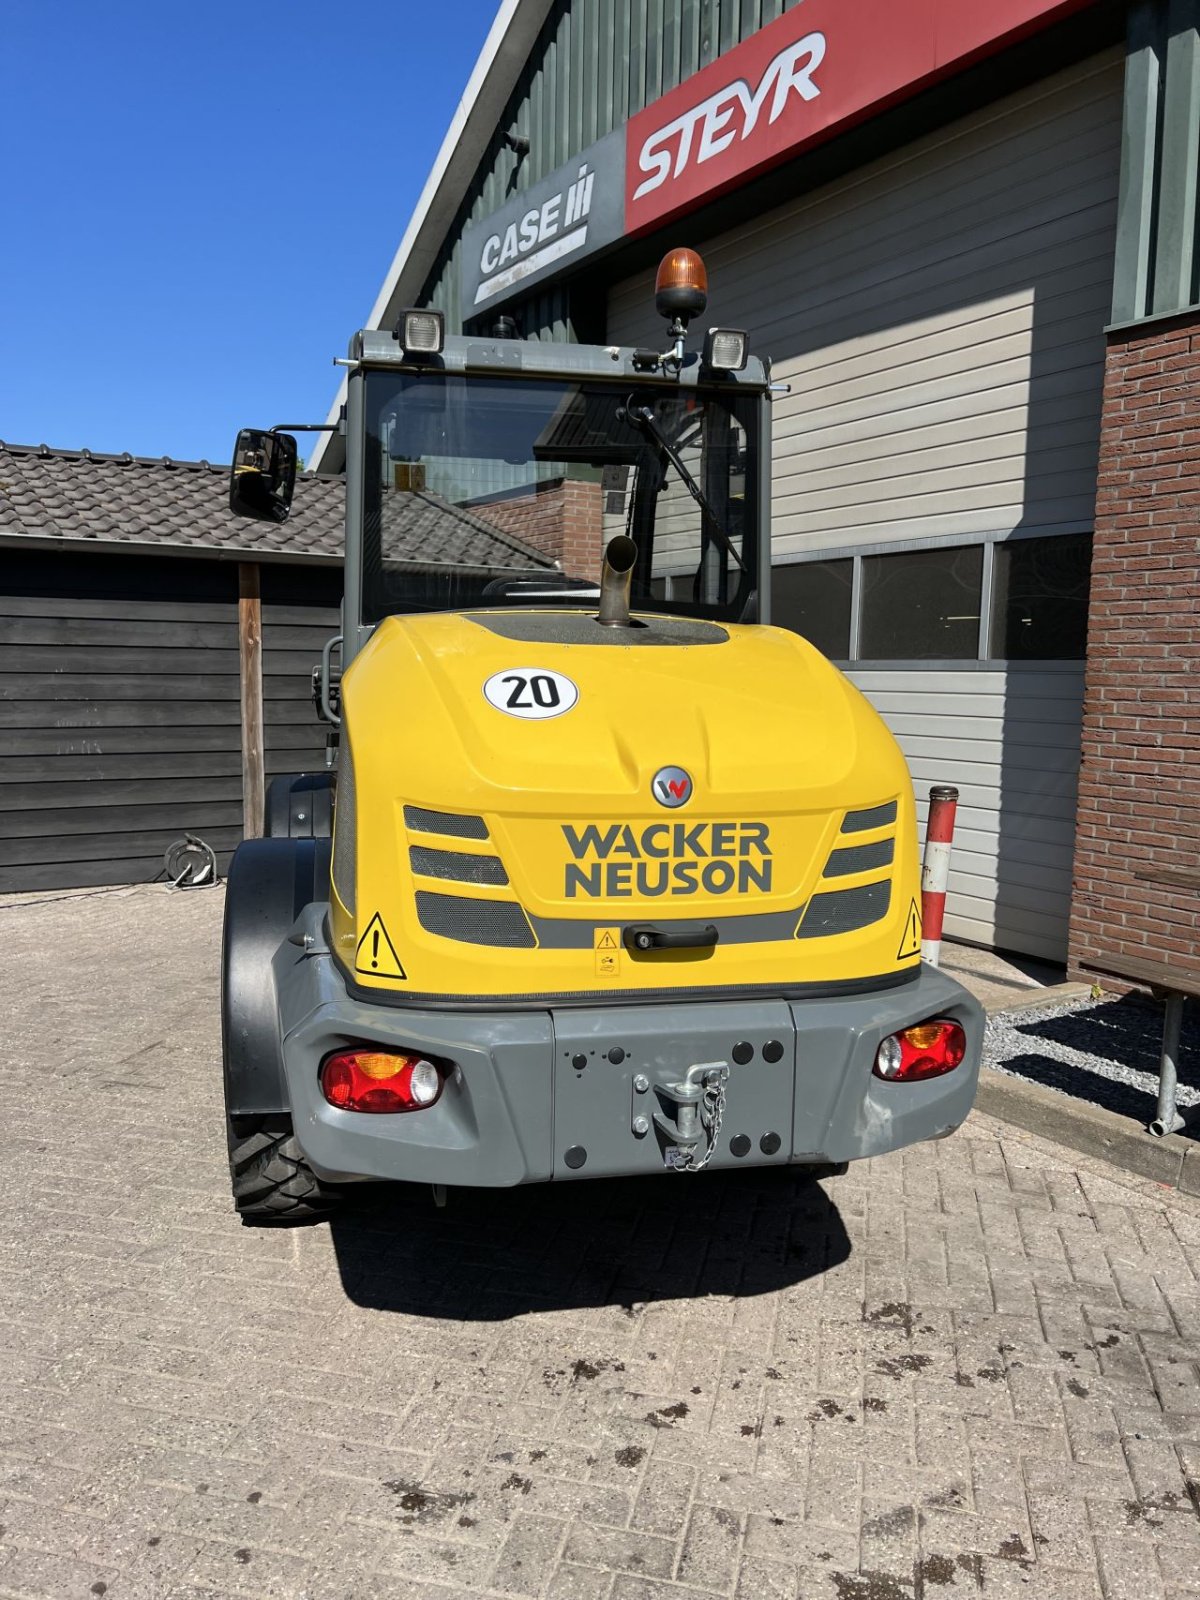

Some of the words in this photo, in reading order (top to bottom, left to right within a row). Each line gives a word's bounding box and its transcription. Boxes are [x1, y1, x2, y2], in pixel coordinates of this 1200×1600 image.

[633, 31, 826, 200] STEYR
[480, 193, 562, 273] CASE
[501, 675, 561, 708] 20
[560, 822, 773, 859] WACKER
[564, 859, 773, 898] NEUSON
